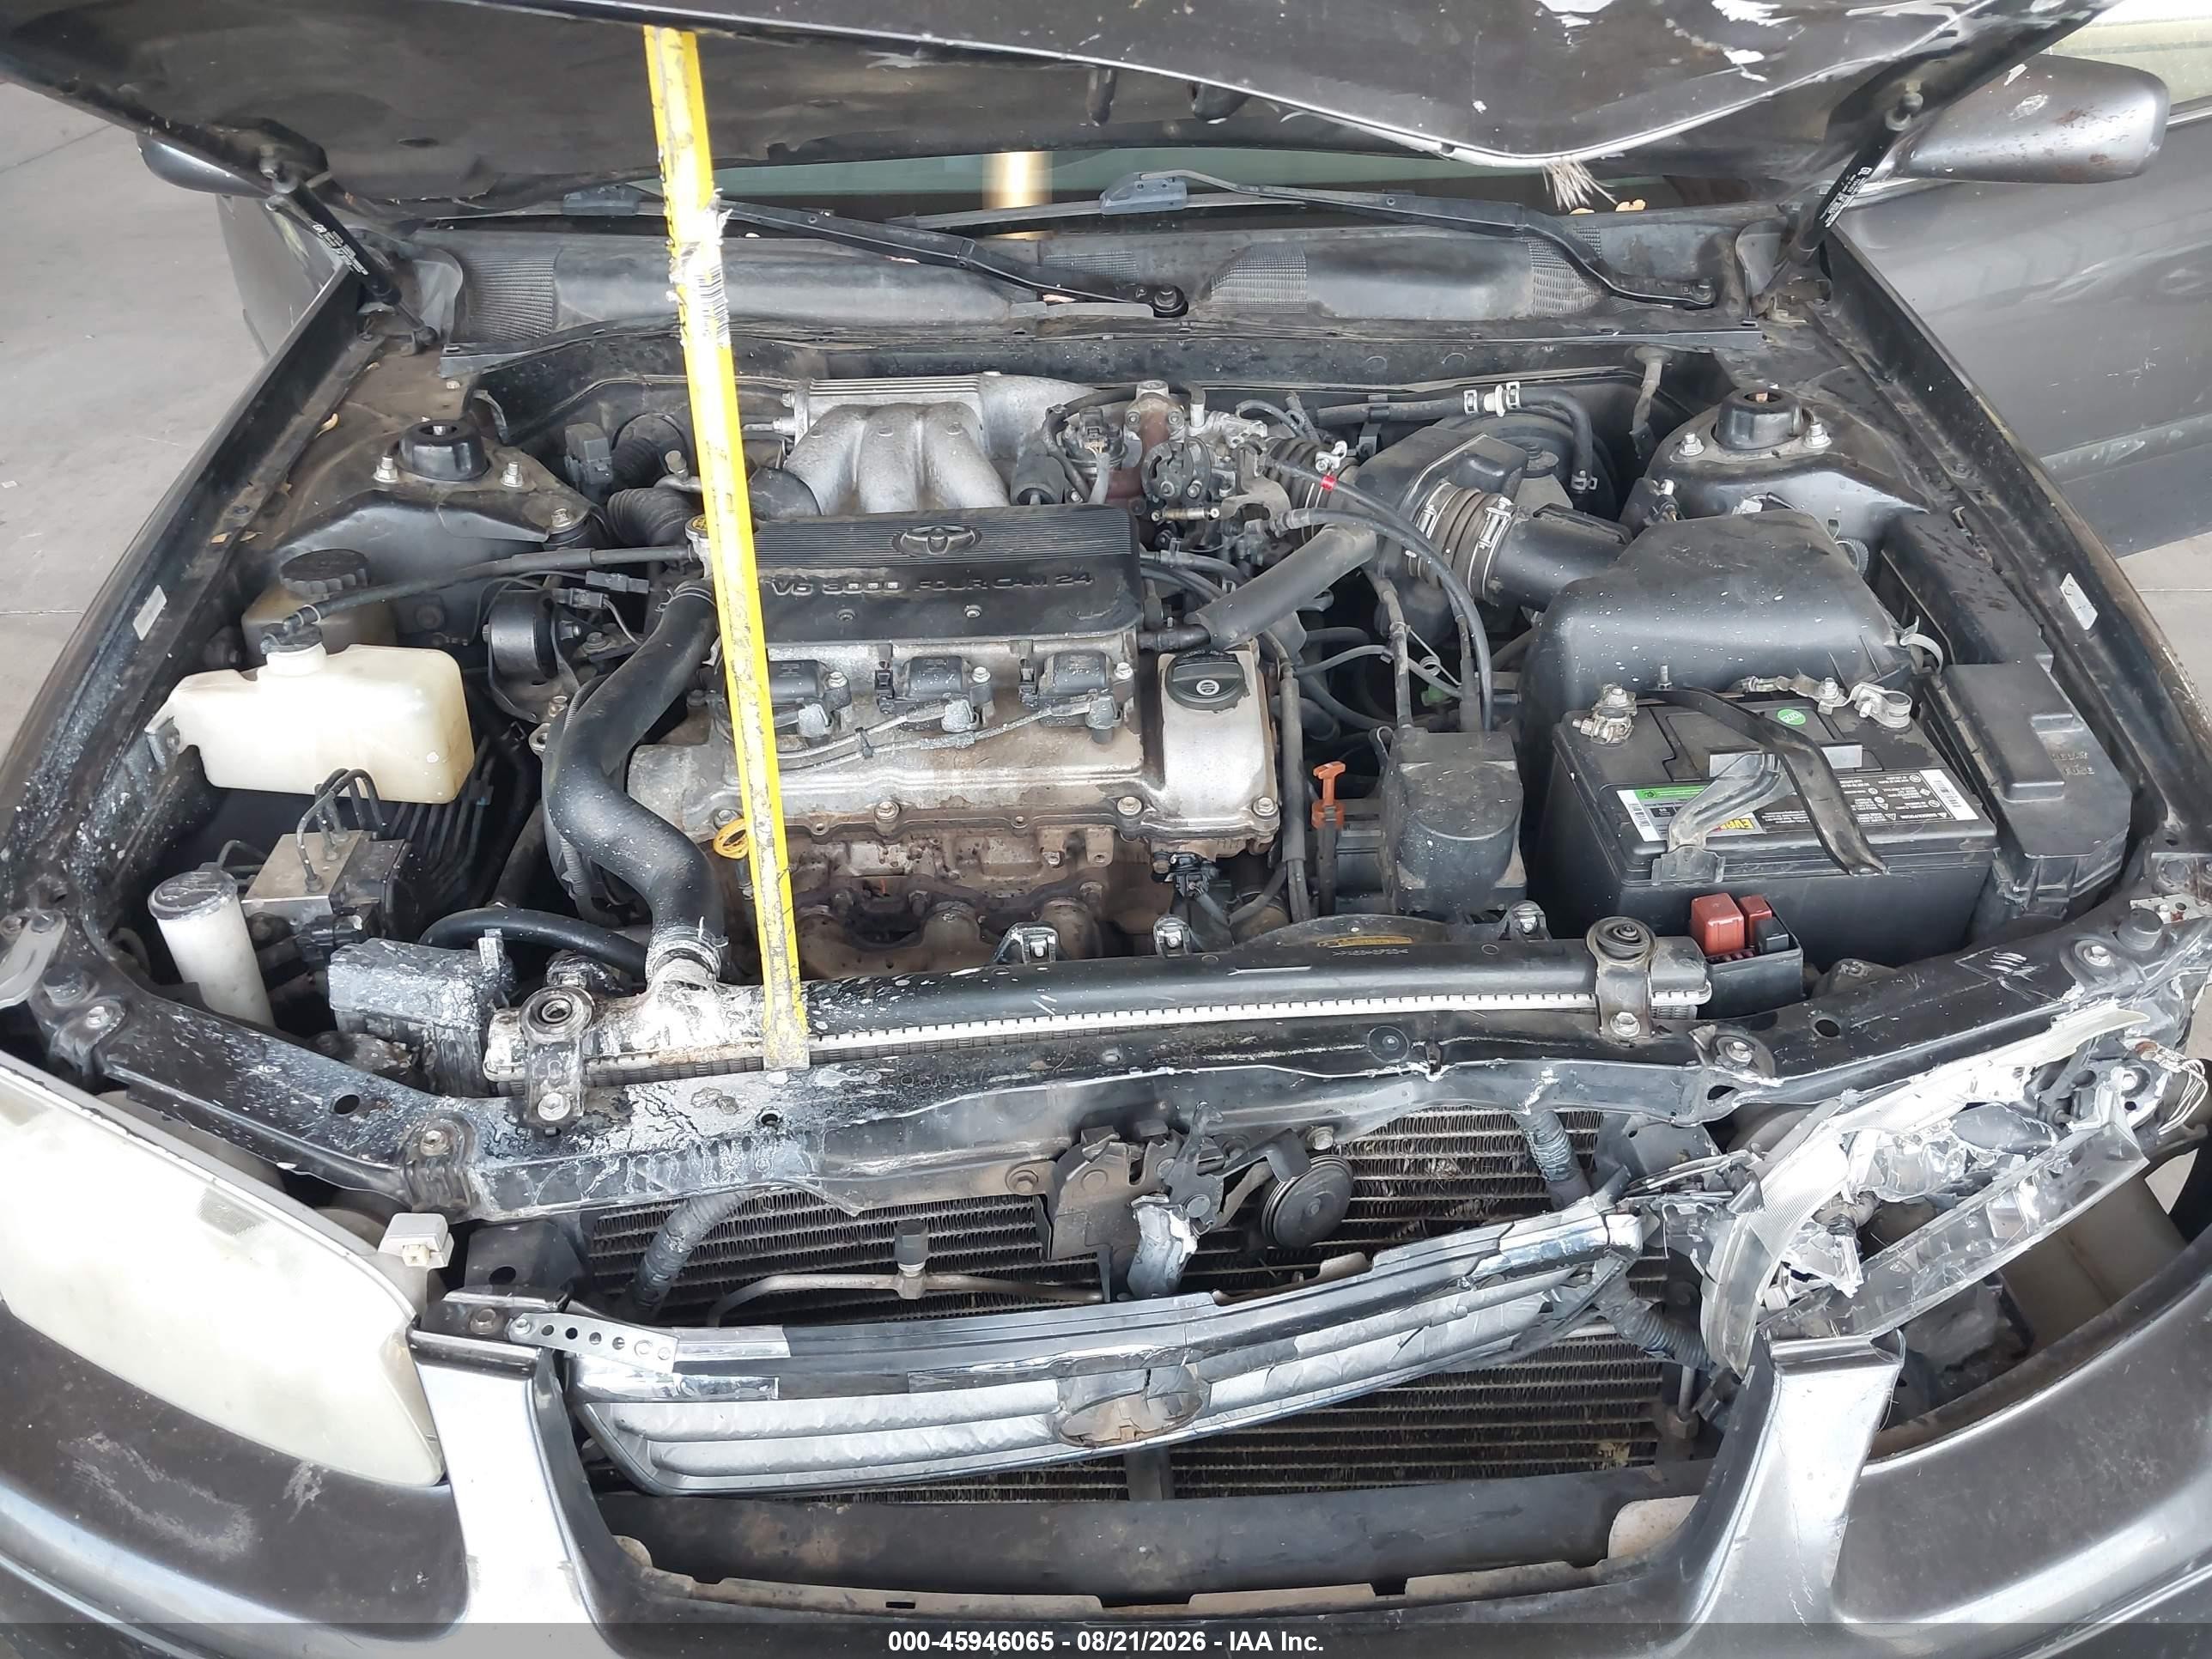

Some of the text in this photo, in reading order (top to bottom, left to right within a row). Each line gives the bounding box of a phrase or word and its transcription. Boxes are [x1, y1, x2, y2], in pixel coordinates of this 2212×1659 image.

[822, 577, 904, 595] 3000
[914, 578, 988, 591] FOUR
[993, 576, 1049, 589] CAM
[1055, 574, 1094, 587] 24
